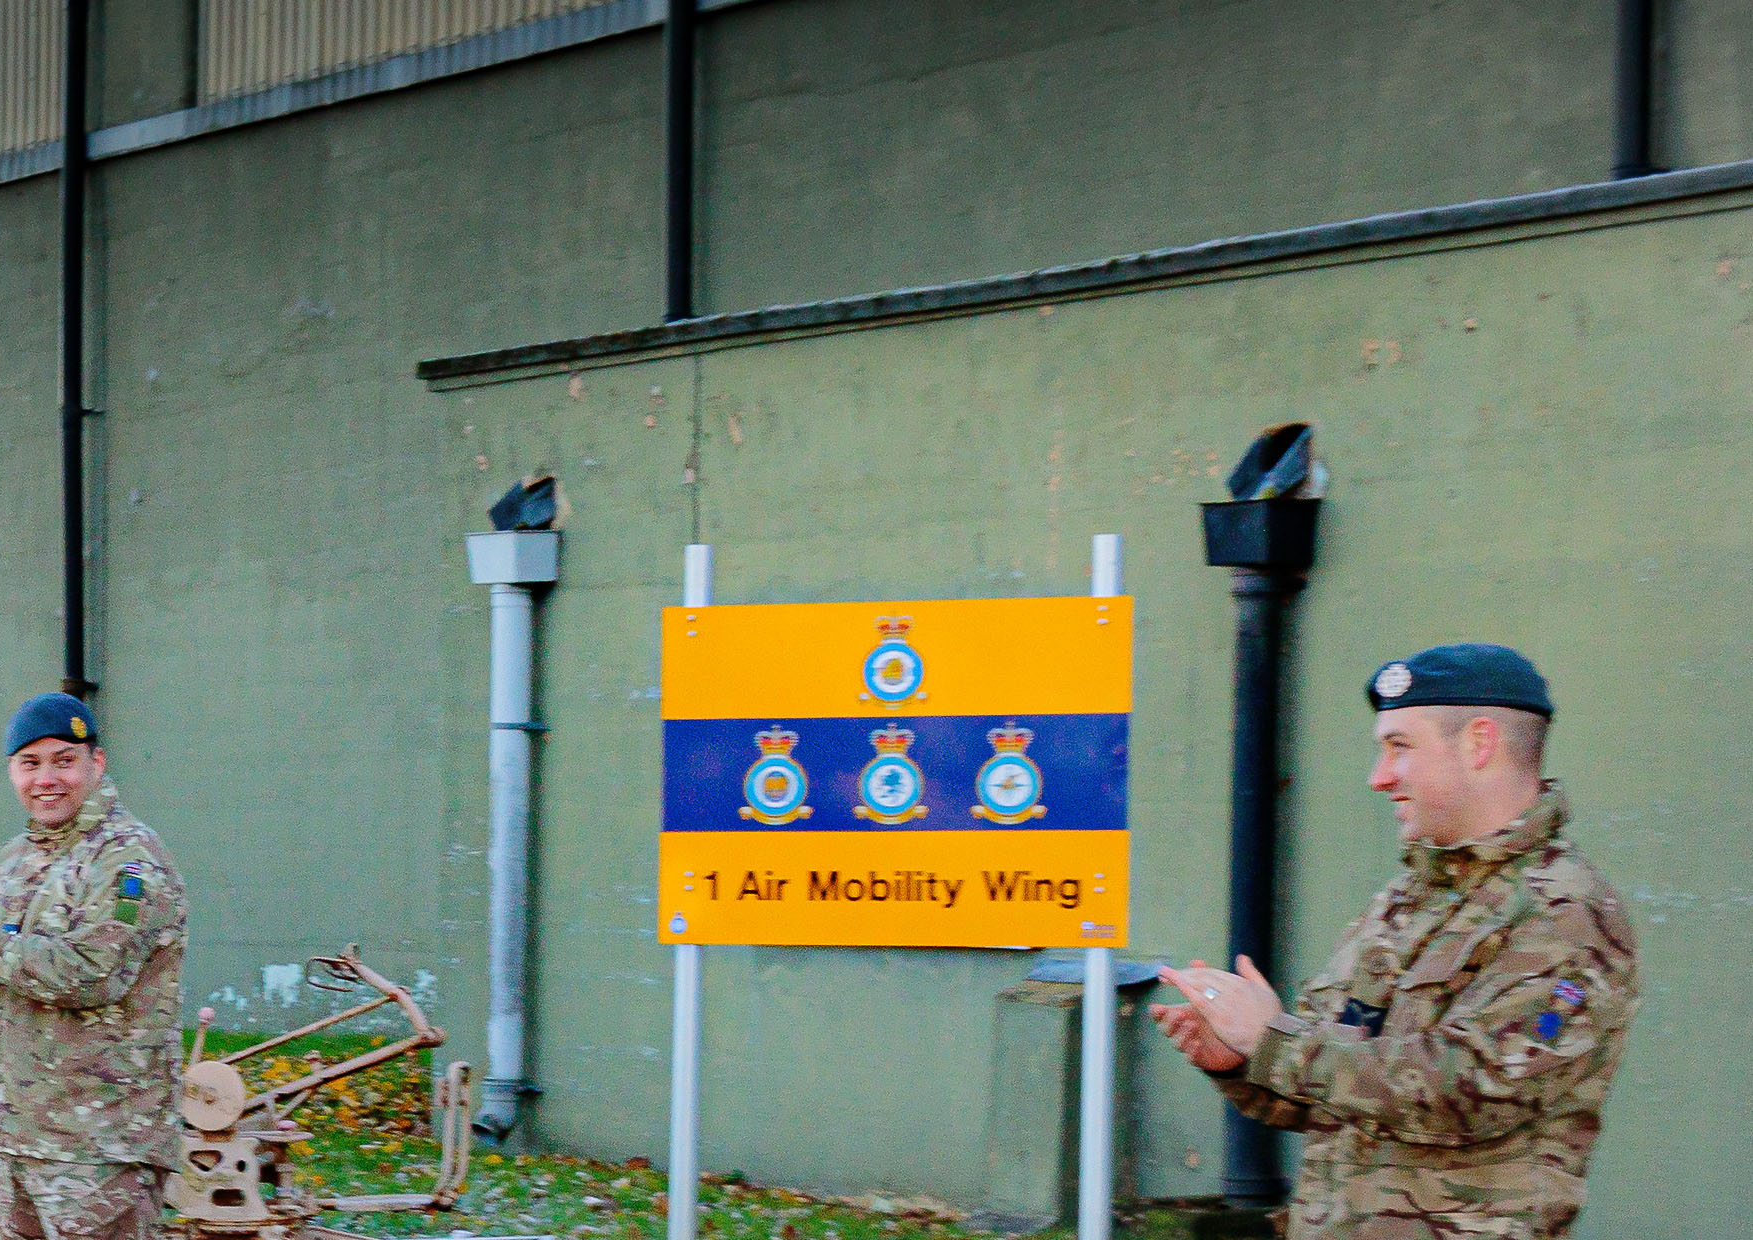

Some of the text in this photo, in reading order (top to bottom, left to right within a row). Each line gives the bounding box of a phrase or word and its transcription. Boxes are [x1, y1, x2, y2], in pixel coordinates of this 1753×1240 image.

[702, 870, 1083, 910] 1 Air Mobility Wing
